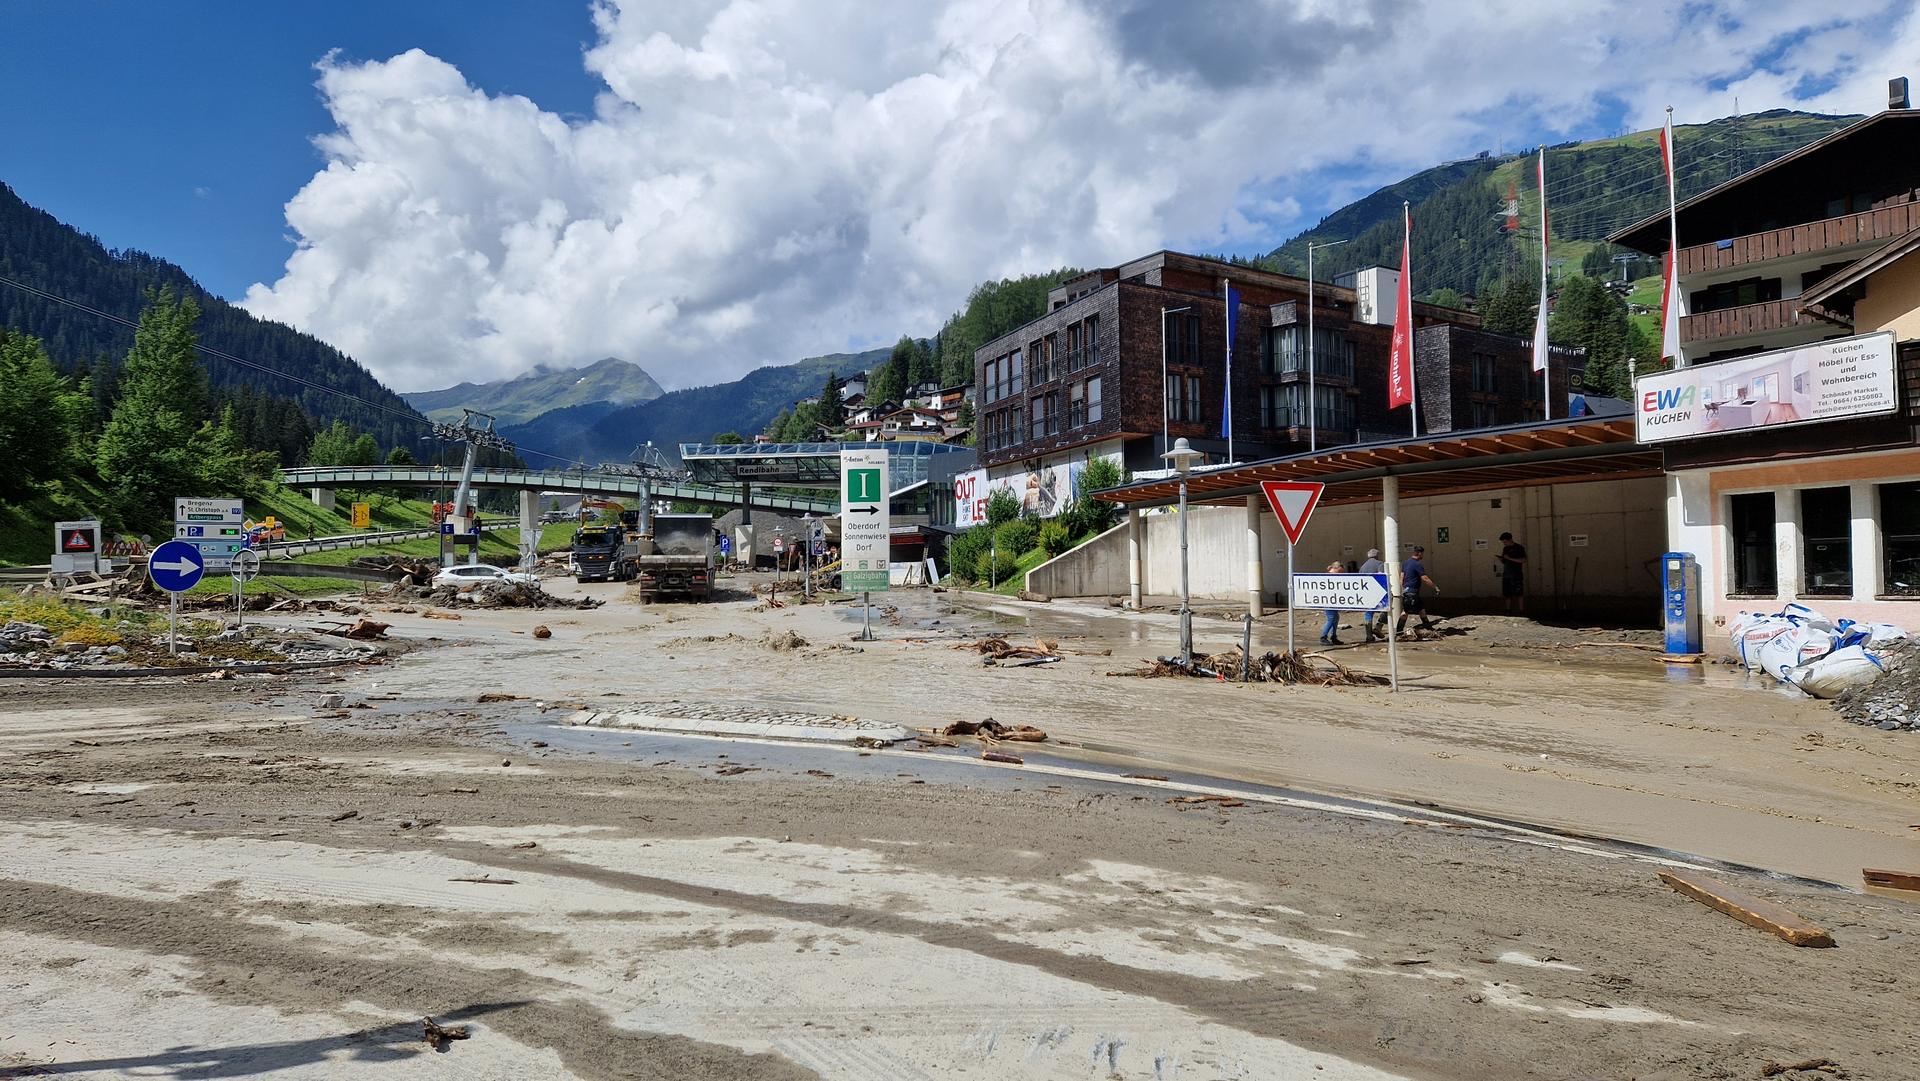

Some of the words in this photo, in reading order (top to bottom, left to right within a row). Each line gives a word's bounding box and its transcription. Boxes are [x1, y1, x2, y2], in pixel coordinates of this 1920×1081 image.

[1832, 344, 1864, 354] Küchen
[1818, 357, 1843, 368] Möbel
[1845, 356, 1858, 364] für
[1860, 353, 1879, 361] Ess-
[1840, 365, 1857, 373] und
[1821, 371, 1877, 386] Wohnbereich
[1643, 384, 1696, 412] EWA
[1822, 390, 1852, 399] Schönach
[1854, 386, 1878, 394] Markus
[1646, 411, 1691, 426] KÜCHEN
[955, 477, 976, 500] OUT
[190, 527, 198, 536] P
[848, 522, 880, 530] Oberdorf
[721, 538, 729, 548] P
[852, 571, 887, 580] Galzigbahn
[1298, 578, 1369, 591] Innsbruck
[1304, 593, 1364, 605] Landeck
